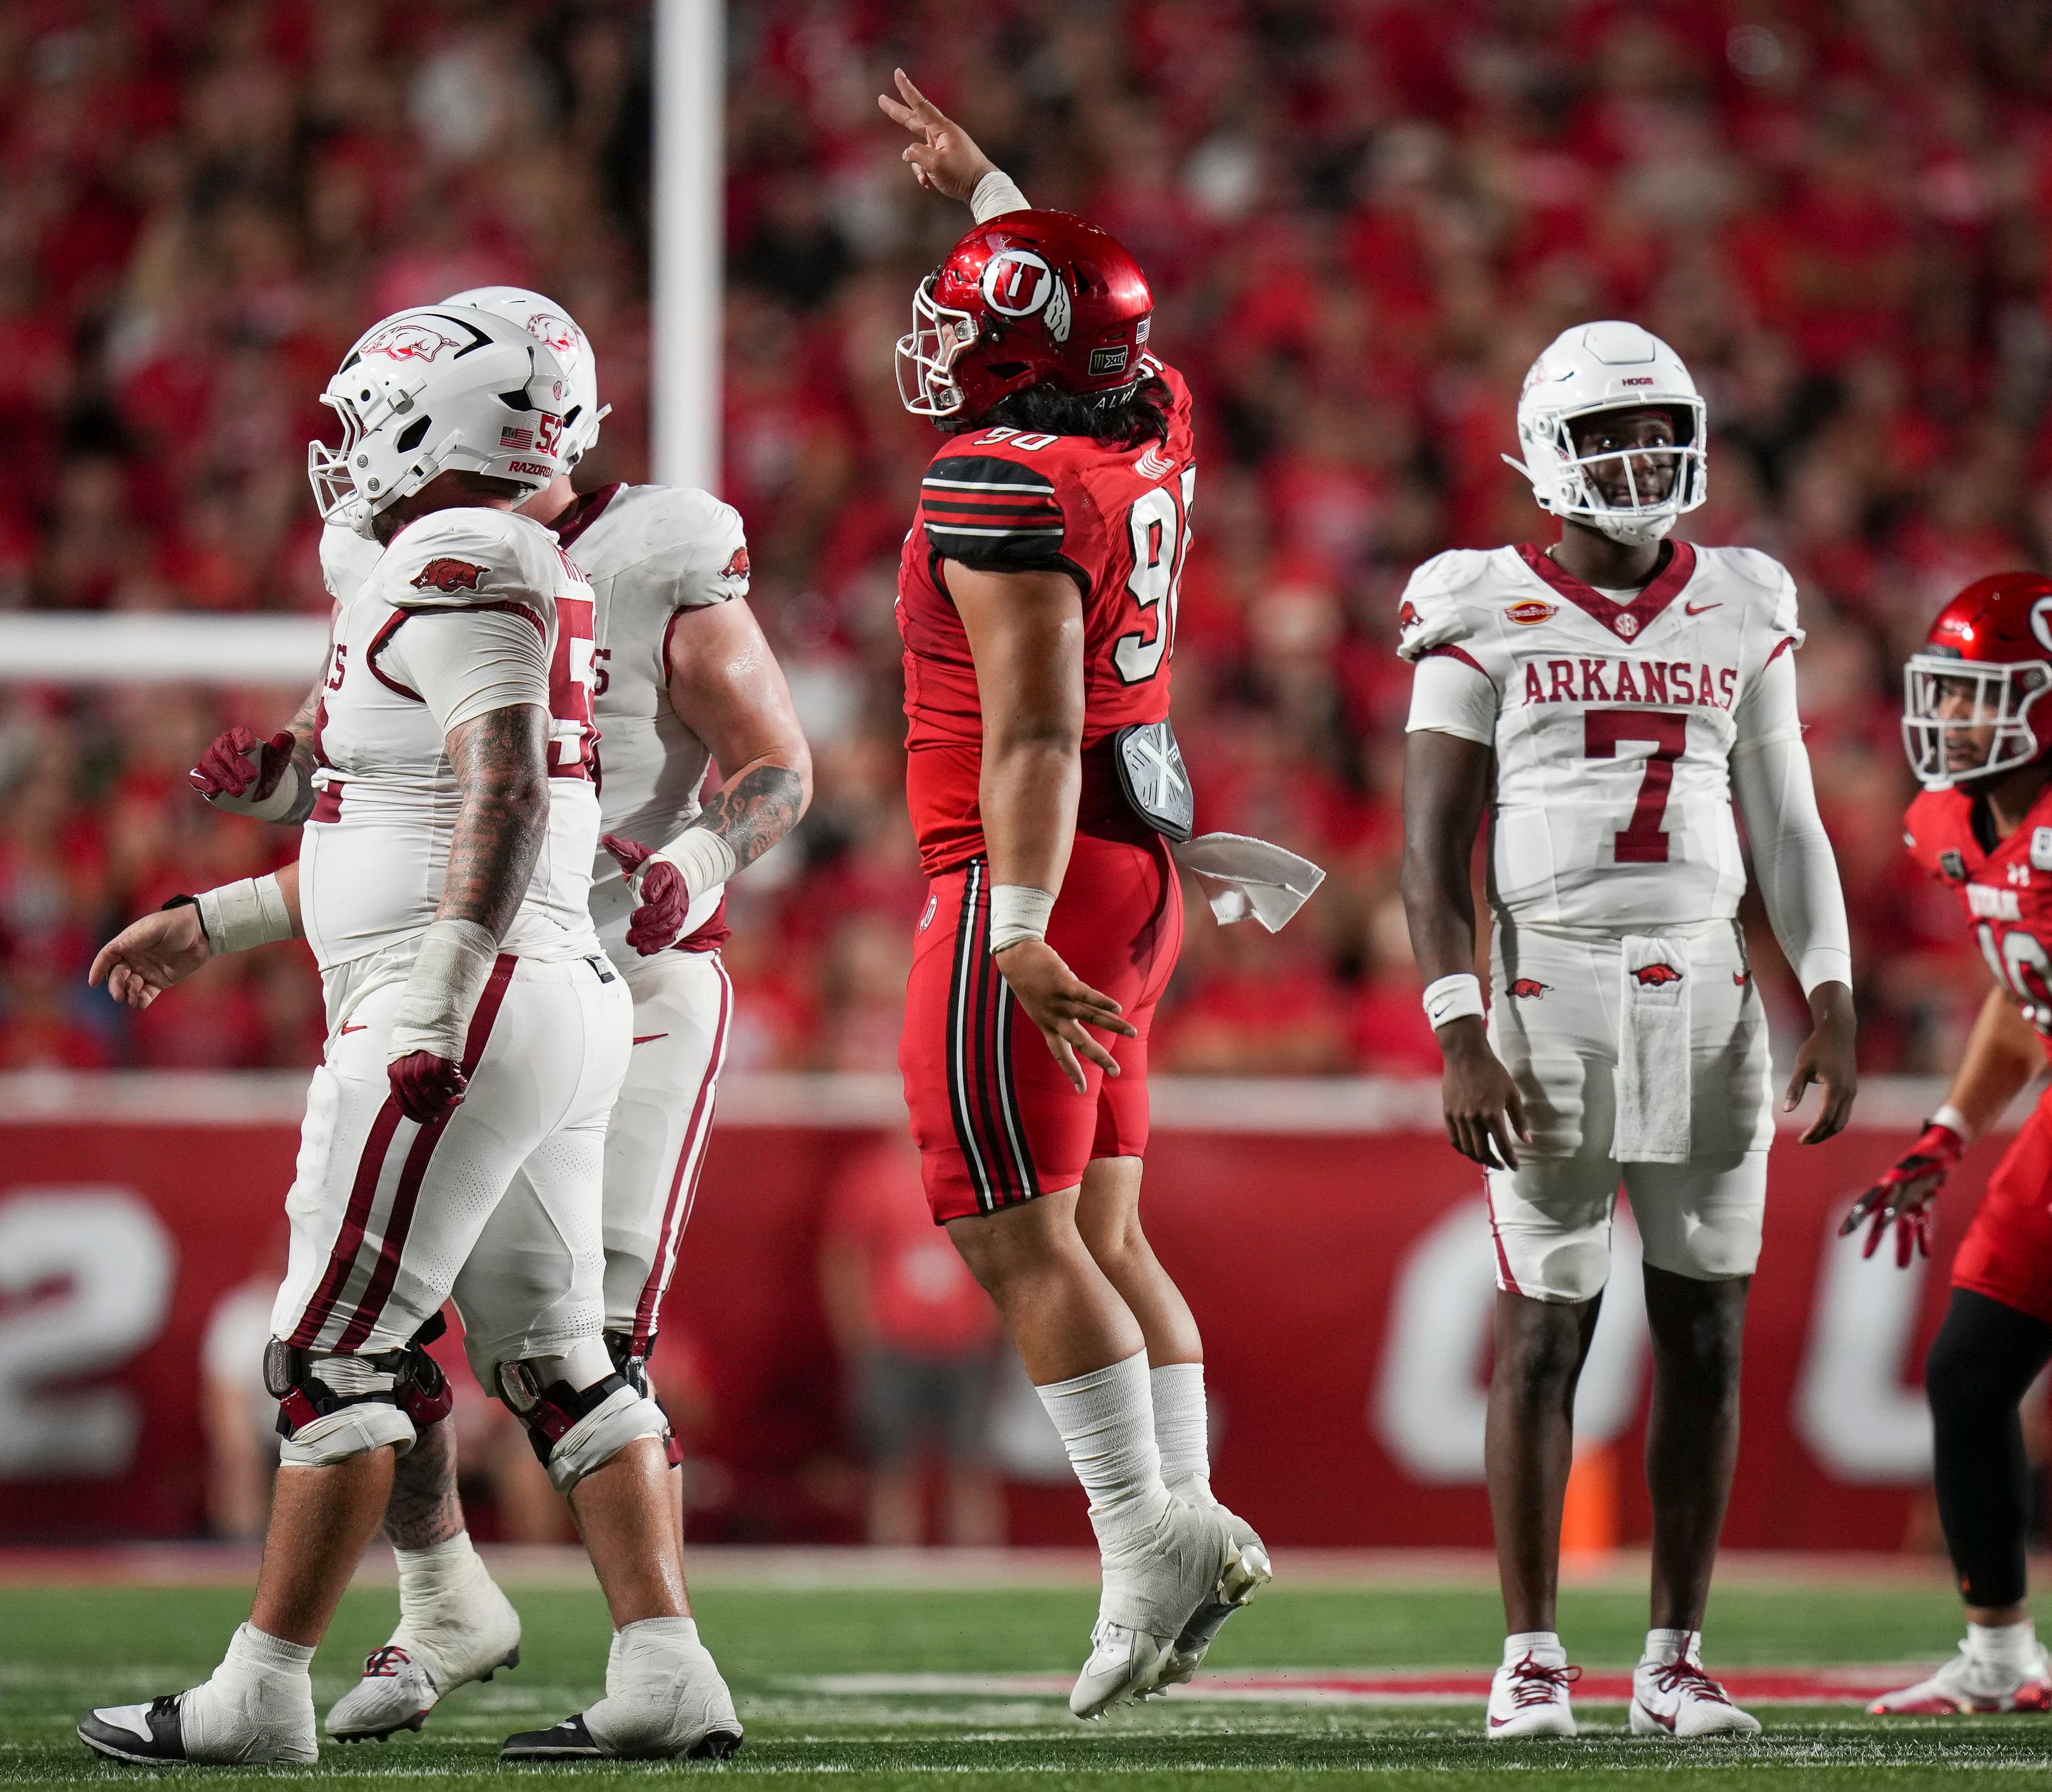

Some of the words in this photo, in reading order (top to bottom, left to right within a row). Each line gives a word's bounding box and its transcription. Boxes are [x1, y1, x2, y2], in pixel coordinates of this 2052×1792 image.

[993, 258, 1046, 312] U
[535, 414, 562, 459] 52
[973, 426, 1060, 451] 90
[508, 460, 555, 479] RAZORBA
[1521, 659, 1738, 712] ARKANSAS
[1584, 710, 1688, 862] 7
